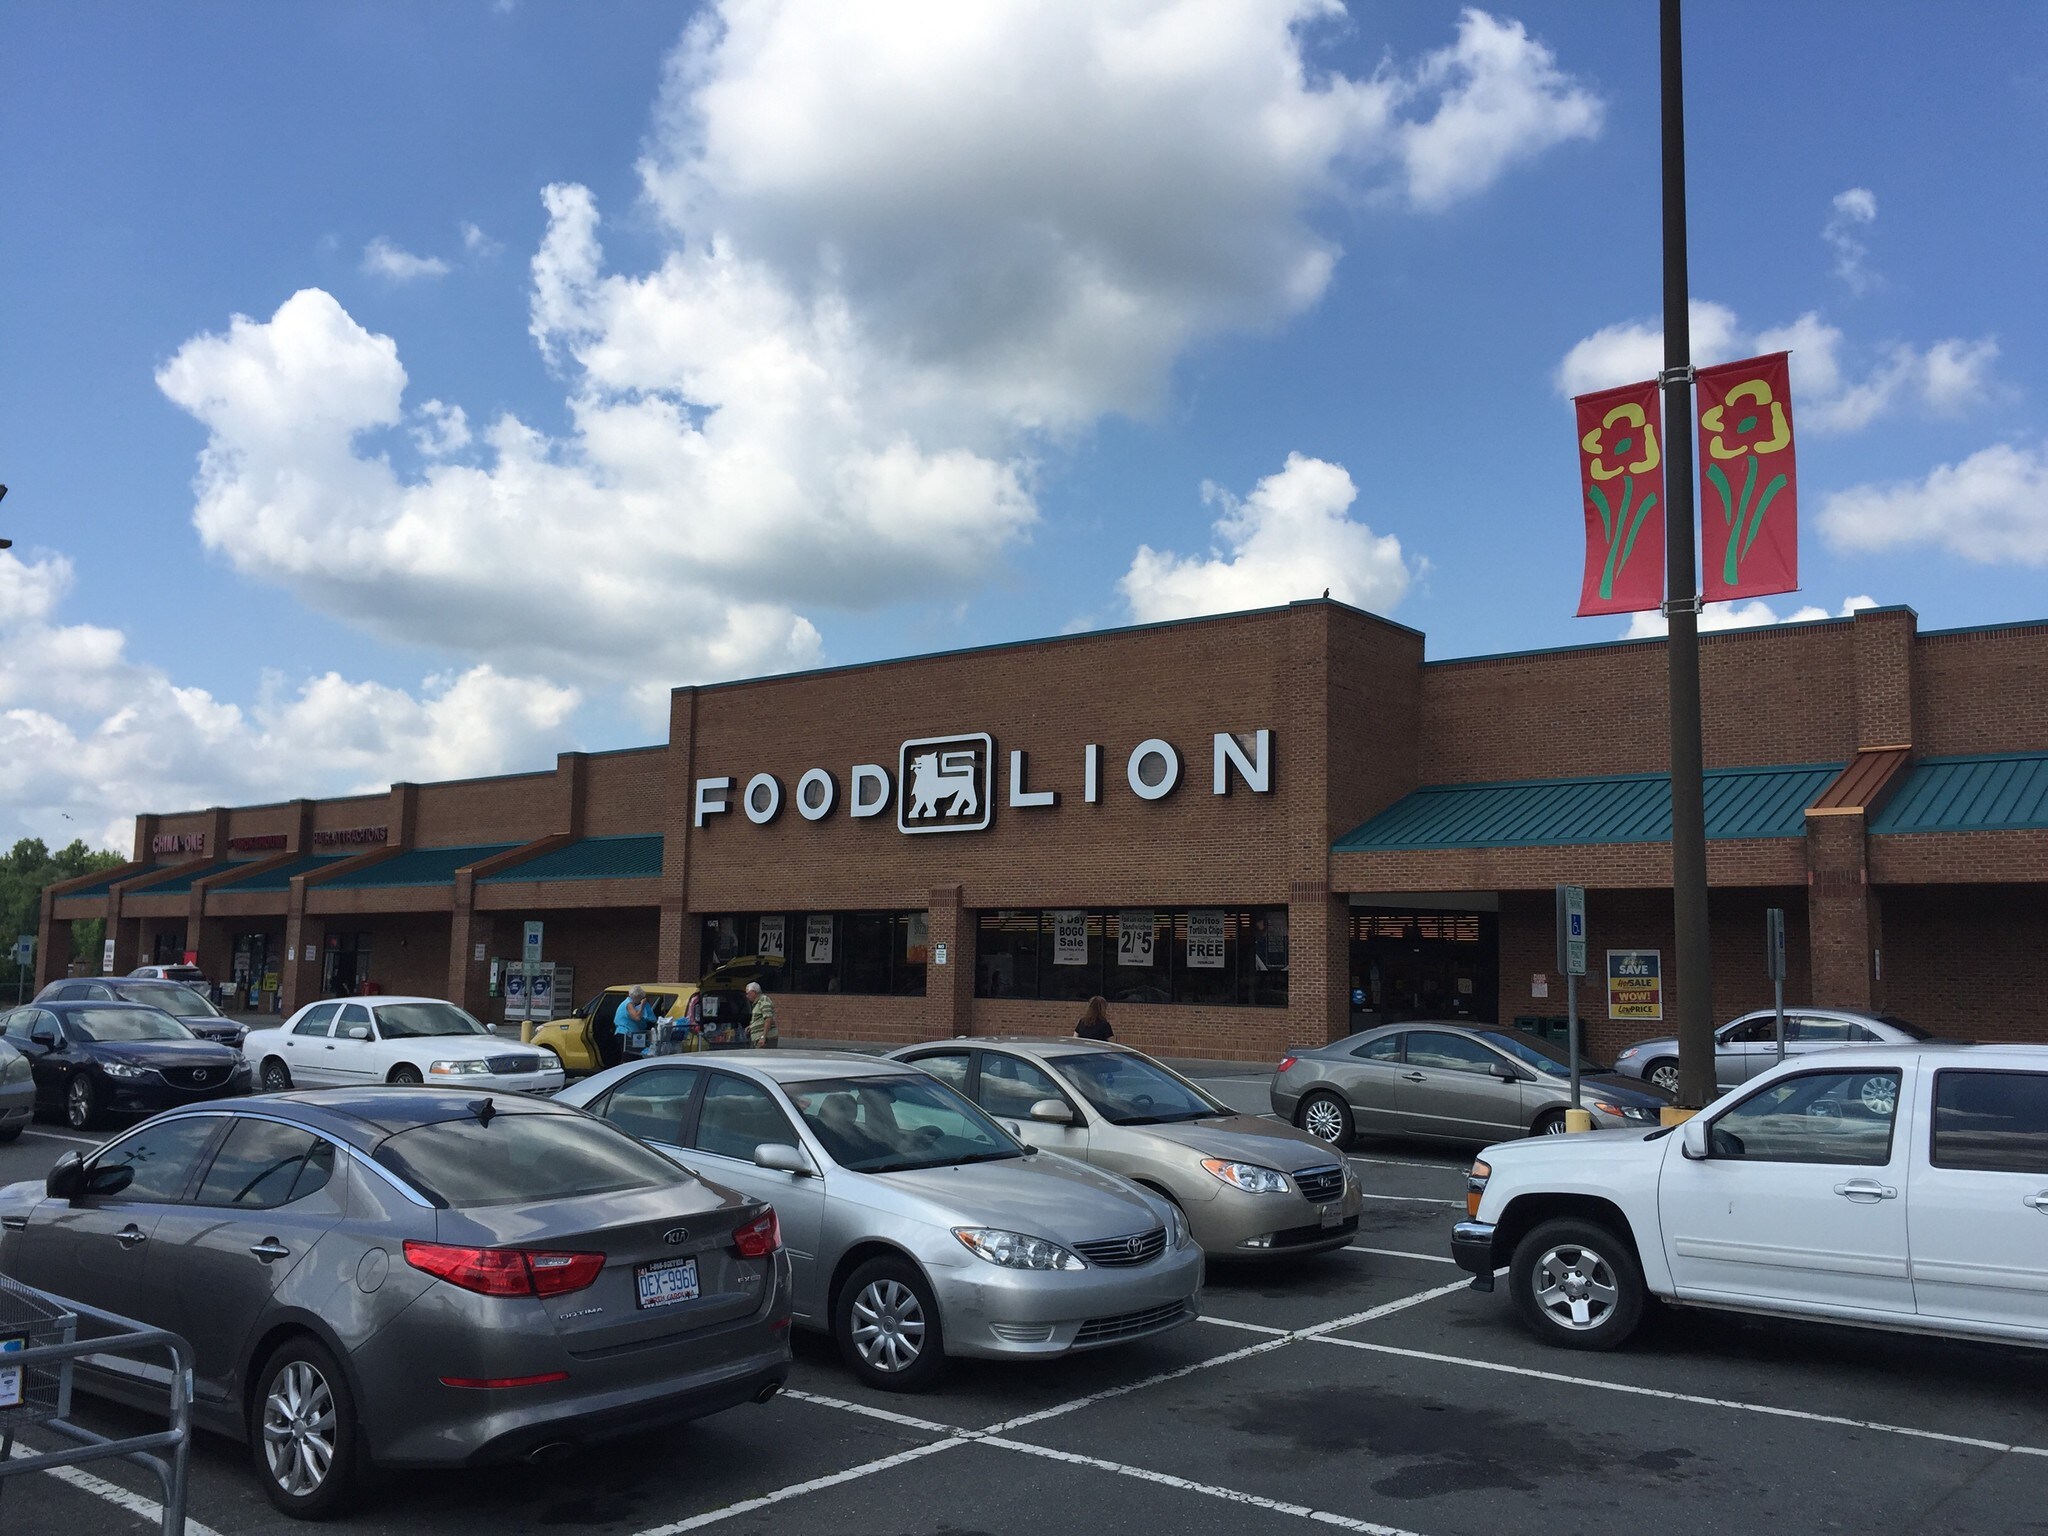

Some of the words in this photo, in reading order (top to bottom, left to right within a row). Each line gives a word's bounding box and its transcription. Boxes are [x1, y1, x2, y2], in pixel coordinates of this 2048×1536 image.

[695, 764, 889, 827] FOOD
[1010, 729, 1268, 806] LION
[153, 835, 179, 853] CHINA
[184, 833, 204, 851] ONE
[1067, 914, 1086, 926] Day
[1192, 917, 1220, 925] Doritos
[1060, 927, 1084, 937] BOGO
[761, 932, 782, 952] 2/$4
[1060, 937, 1084, 947] Sale
[1121, 930, 1152, 954] 2/$5
[1189, 944, 1223, 957] FREE
[1619, 965, 1649, 974] SAVE
[1629, 979, 1652, 987] SALE
[1619, 992, 1650, 1001] WOW!
[668, 1232, 686, 1244] KIA
[641, 1267, 697, 1297] DEX-9960
[560, 1307, 603, 1320] OPTIMA
